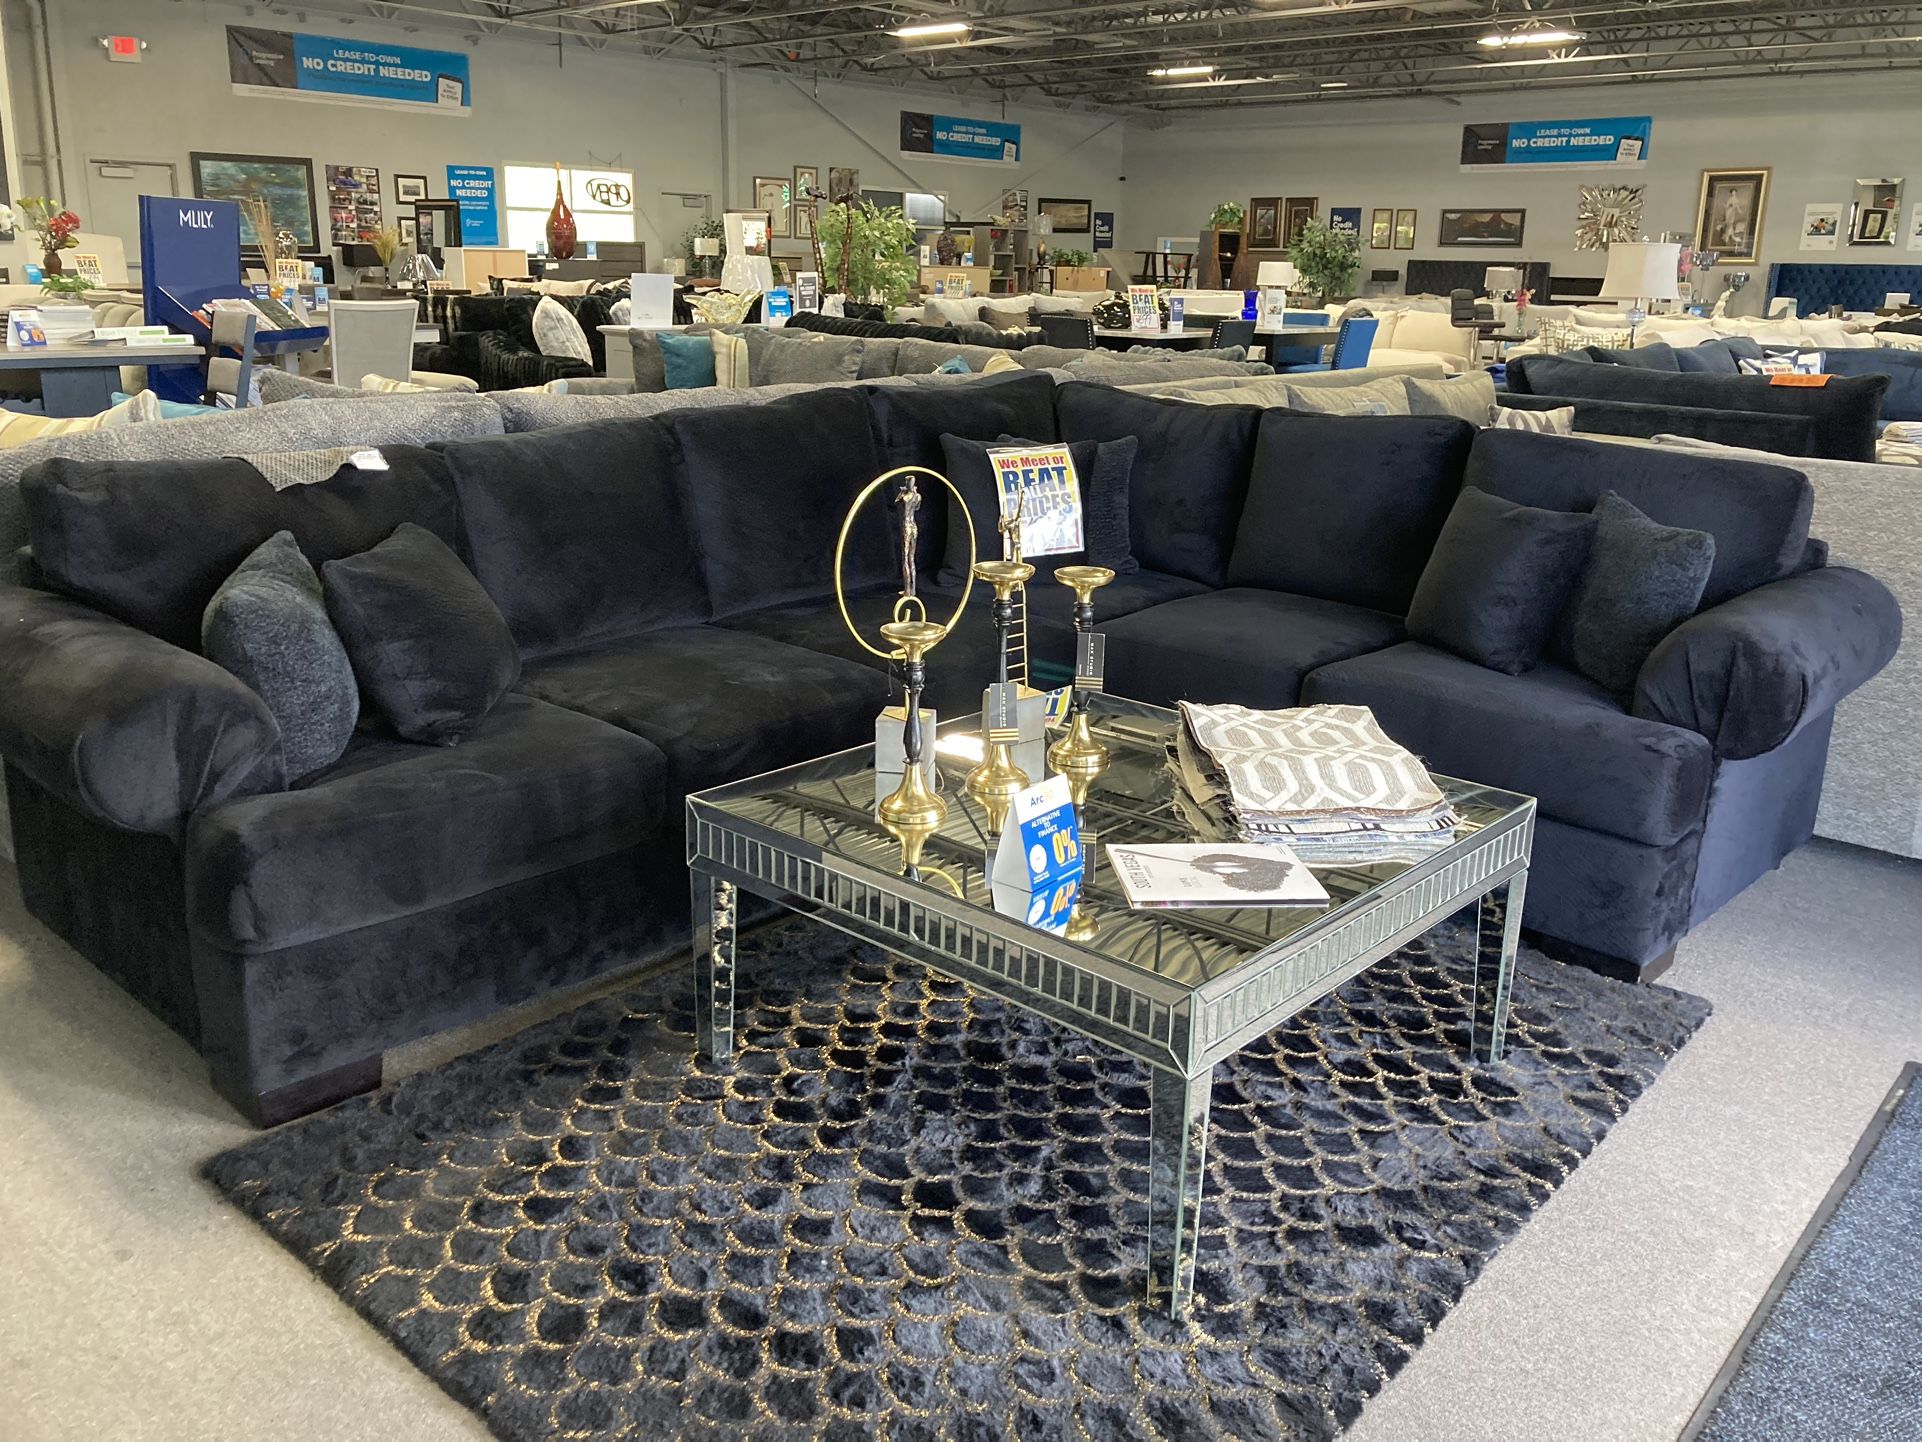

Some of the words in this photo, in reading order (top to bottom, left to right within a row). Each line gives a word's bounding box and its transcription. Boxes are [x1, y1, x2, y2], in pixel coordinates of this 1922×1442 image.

[333, 49, 401, 65] LEASE-TO-OWN
[303, 56, 323, 70] NO
[328, 60, 376, 75] CREDIT
[380, 66, 431, 82] NEEDED
[936, 131, 947, 140] NO
[949, 133, 973, 142] CREDIT
[974, 136, 1001, 146] NEEDED
[1536, 127, 1591, 136] LEASE-TO-OWN
[1512, 138, 1528, 148] NO
[1530, 136, 1567, 147] CREDIT
[1570, 134, 1615, 146] NEEDED
[450, 179, 463, 187] NO
[464, 180, 493, 188] CREDIT
[456, 189, 488, 197] NEEDED
[179, 209, 213, 228] MLILY
[279, 264, 299, 272] BEAT
[1132, 294, 1155, 304] BEAT
[1133, 305, 1157, 314] PRICES
[998, 458, 1019, 469] We
[1020, 455, 1051, 467] Meet
[1053, 455, 1065, 465] or
[1002, 465, 1067, 494] BEAT
[1005, 491, 1073, 519] PRICES
[1031, 809, 1060, 829] ALTERNATIVE
[1044, 821, 1051, 829] TO
[1038, 823, 1058, 838] FINANCE
